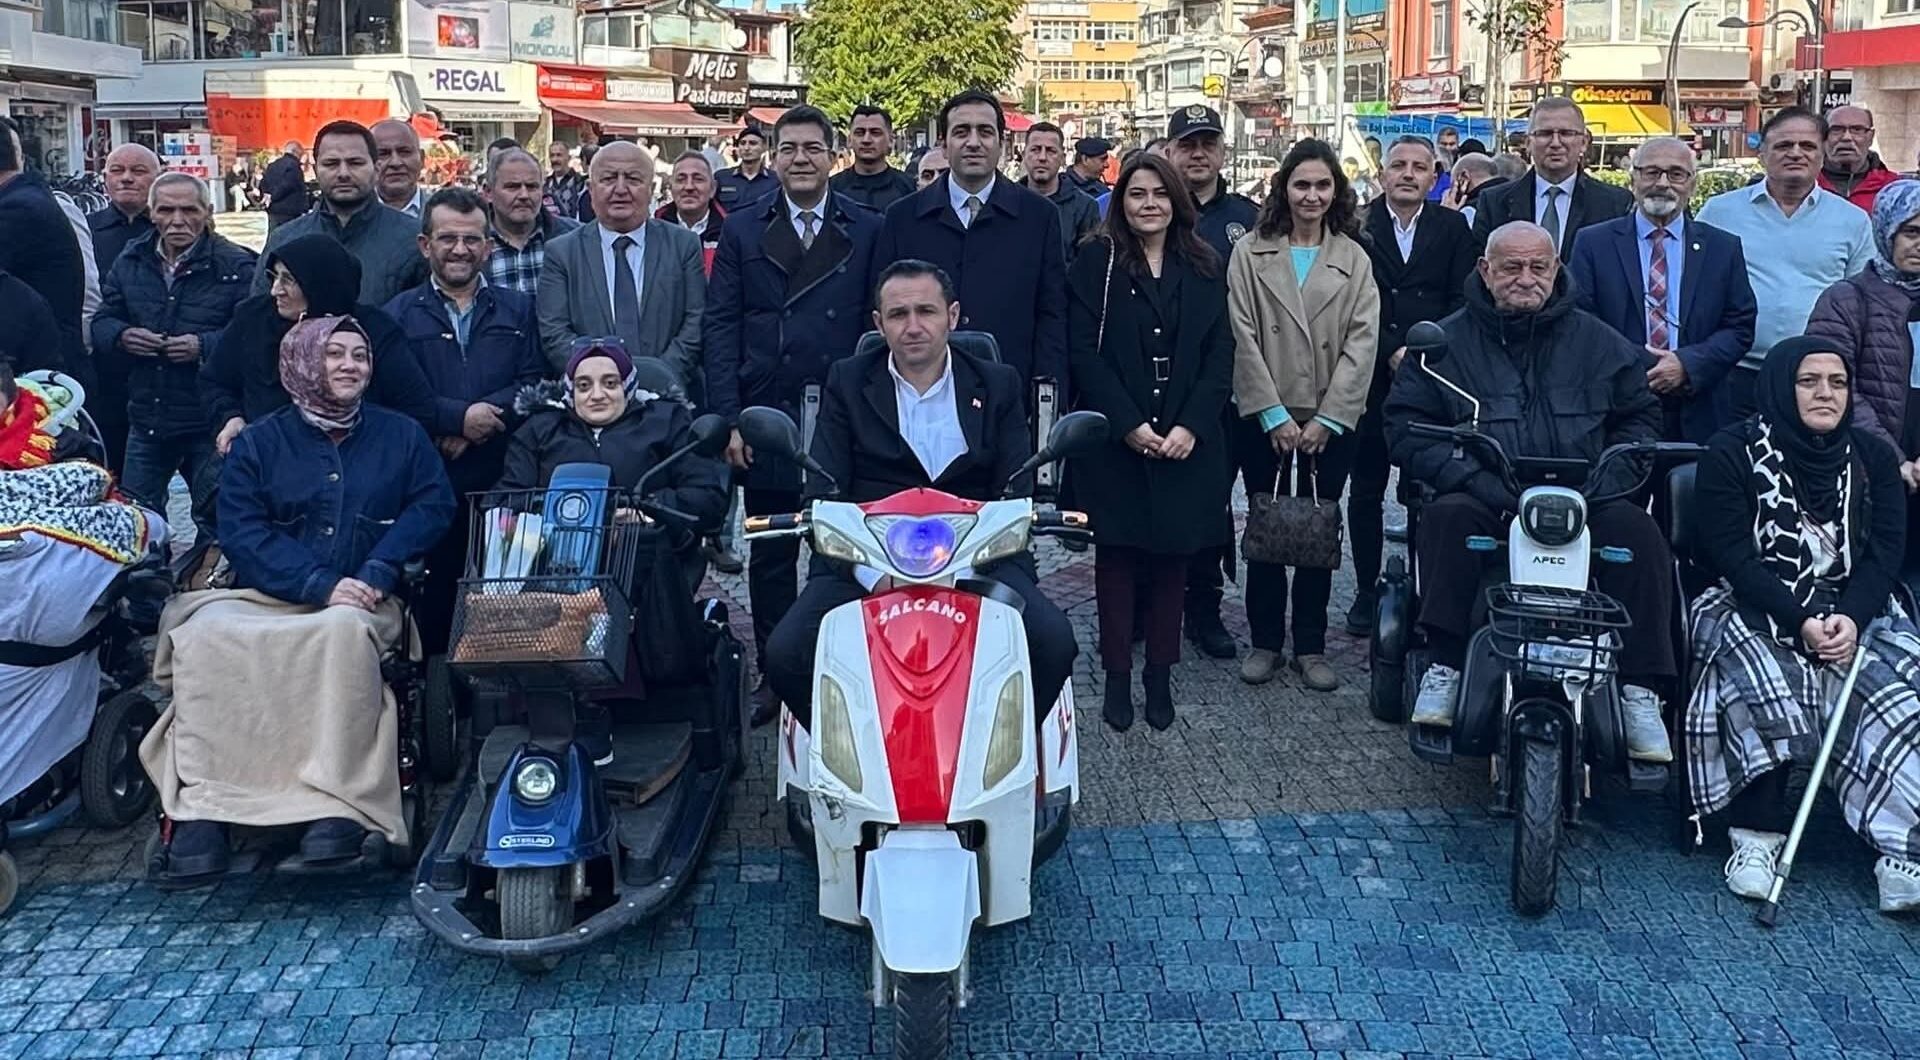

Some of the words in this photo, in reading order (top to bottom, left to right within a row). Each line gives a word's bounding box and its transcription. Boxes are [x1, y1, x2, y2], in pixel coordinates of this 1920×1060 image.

[514, 42, 573, 58] MONDIAL
[685, 52, 738, 82] Melis
[436, 68, 505, 92] REGAL
[676, 83, 748, 106] Pastanesi
[1532, 555, 1567, 565] APEC
[879, 598, 967, 625] SALCANO
